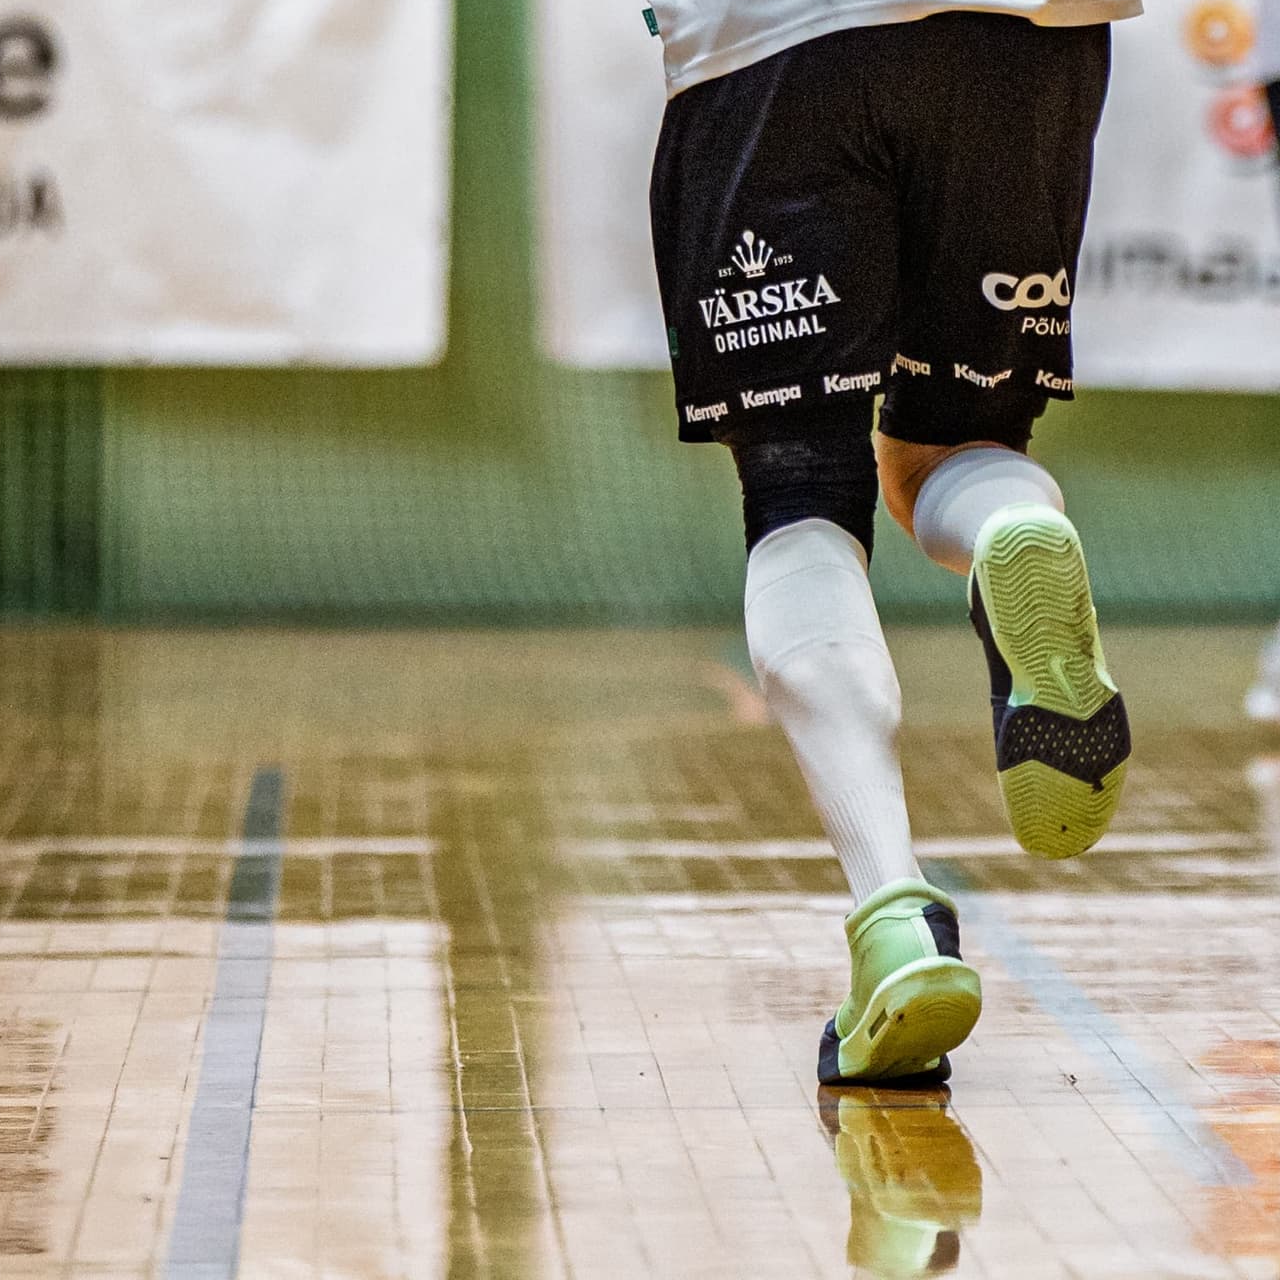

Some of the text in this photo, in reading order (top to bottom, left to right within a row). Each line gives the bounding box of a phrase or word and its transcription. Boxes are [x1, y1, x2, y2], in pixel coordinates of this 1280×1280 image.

[698, 274, 841, 329] VÄRSKA
[715, 314, 827, 354] ORIGINAAL
[685, 371, 881, 423] Kempa Kempa Kempa
[953, 362, 1013, 389] Kempa
[1035, 370, 1074, 392] Kem
